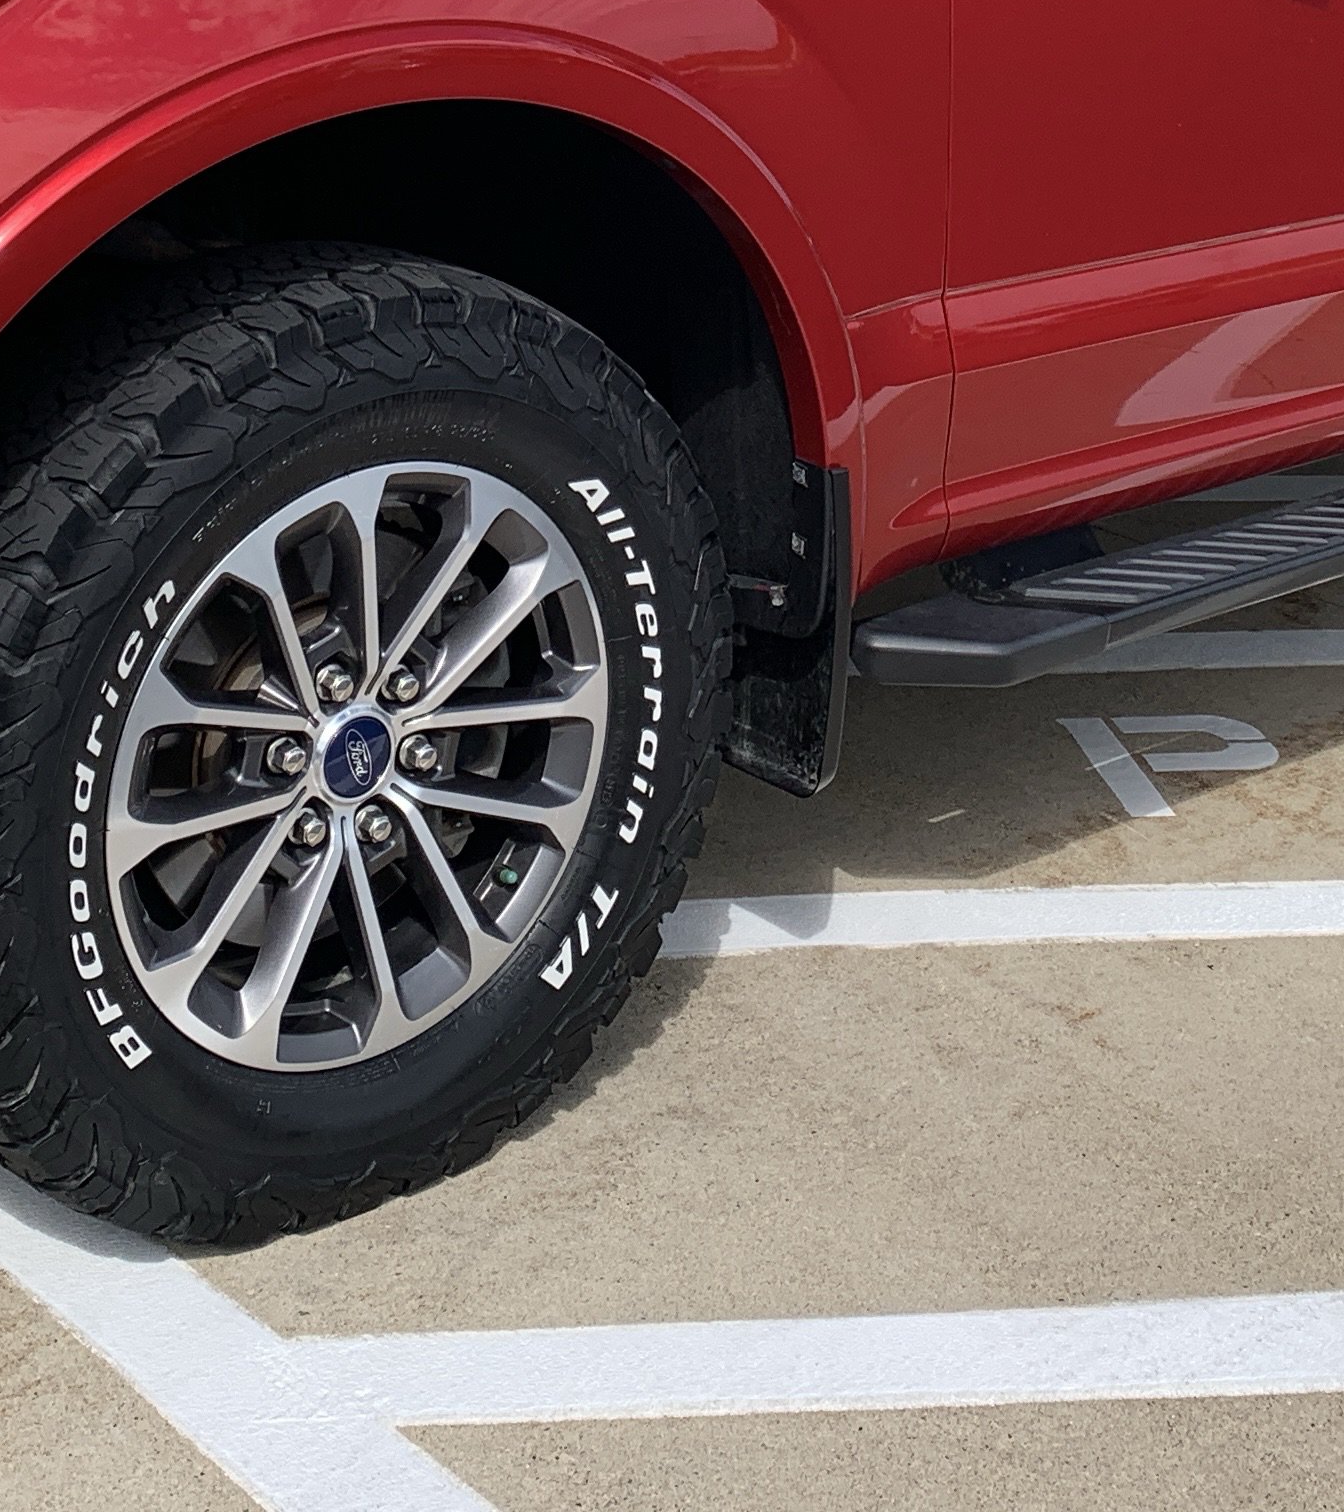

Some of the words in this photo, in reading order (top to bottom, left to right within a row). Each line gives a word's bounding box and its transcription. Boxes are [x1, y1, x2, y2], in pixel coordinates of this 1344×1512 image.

[347, 740, 369, 778] Ford
[567, 478, 663, 844] All-Terrain
[68, 579, 176, 1070] BFGoodrich
[540, 884, 619, 990] T/A
